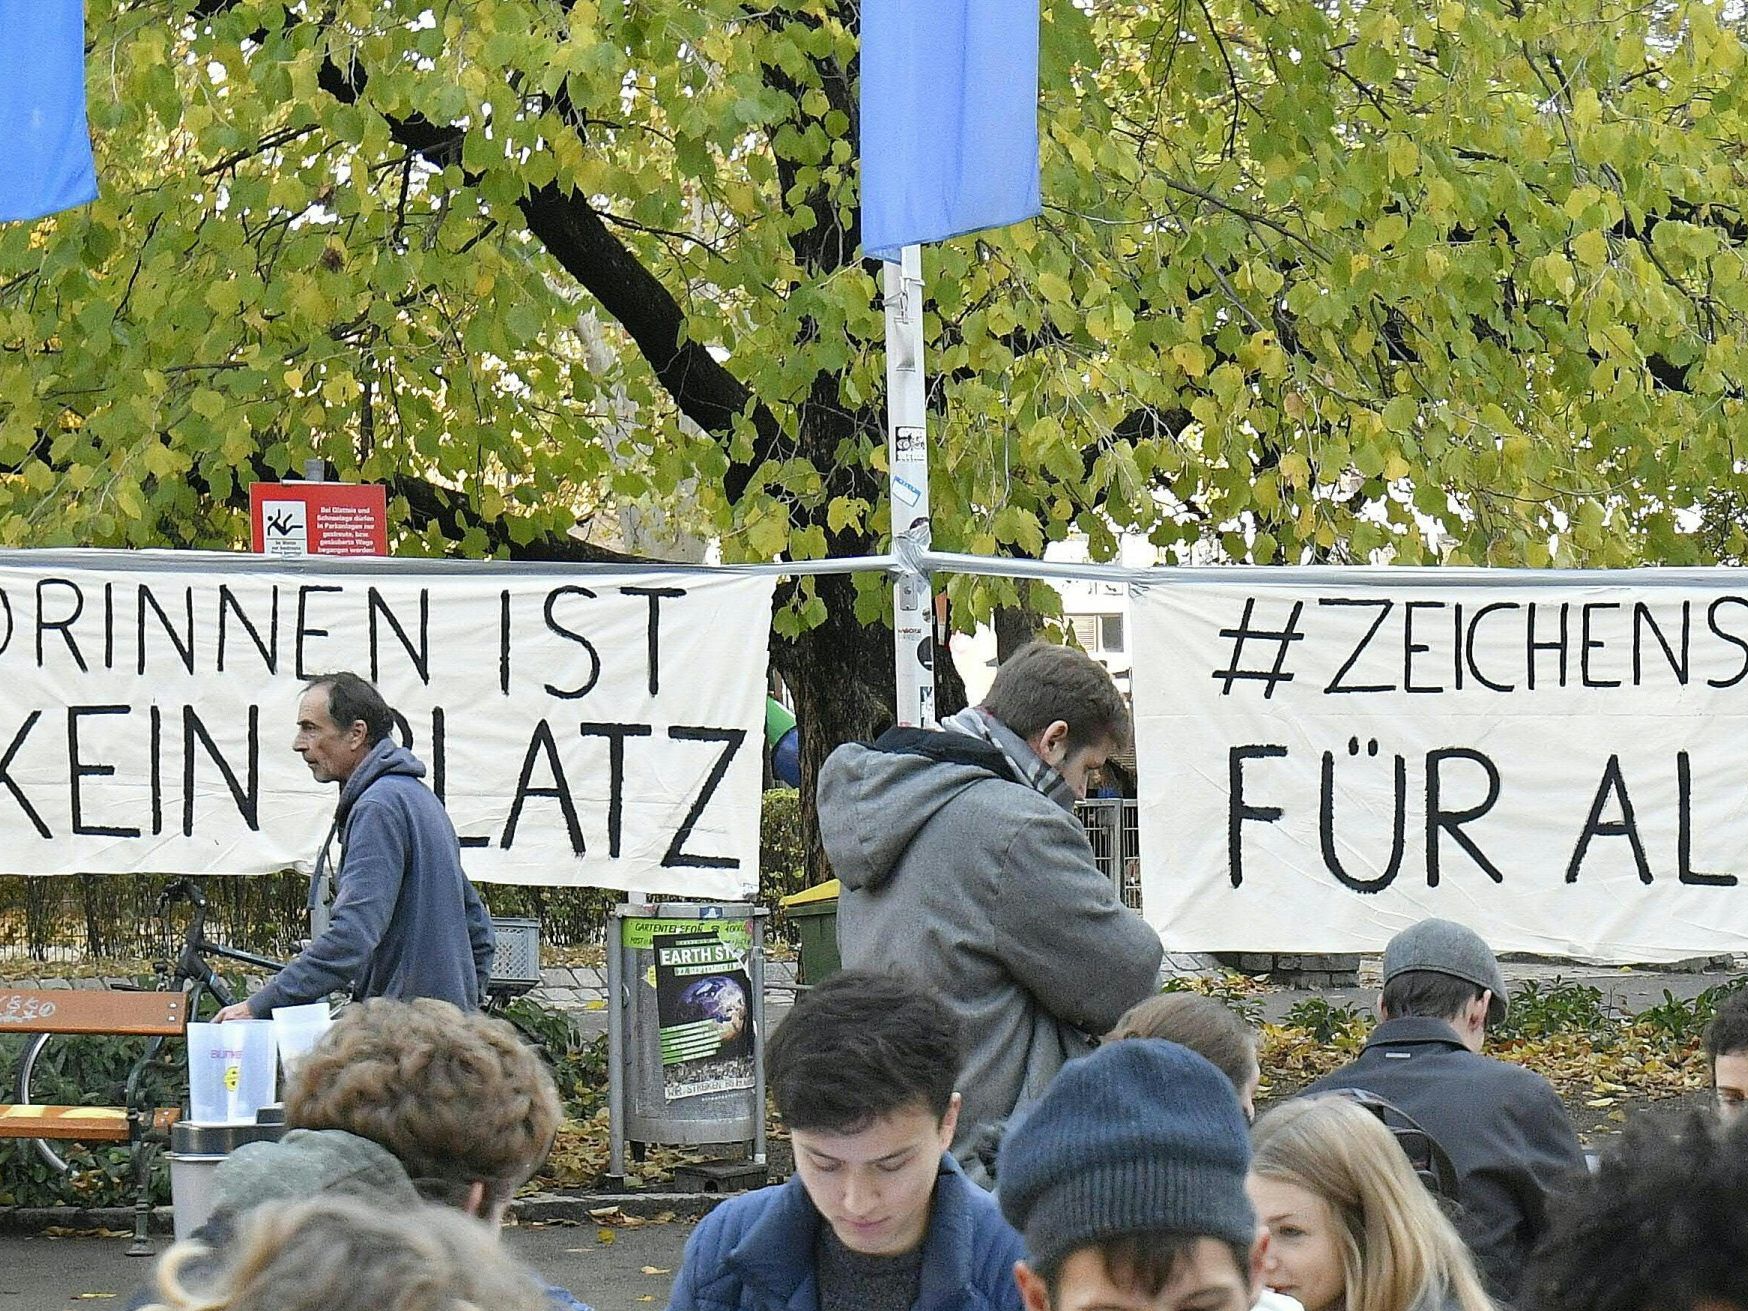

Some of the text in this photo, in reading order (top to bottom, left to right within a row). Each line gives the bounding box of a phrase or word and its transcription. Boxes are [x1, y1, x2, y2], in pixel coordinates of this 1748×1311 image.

[500, 585, 687, 700] IST
[1227, 736, 1504, 895] FÜR
[660, 948, 712, 964] EARTH
